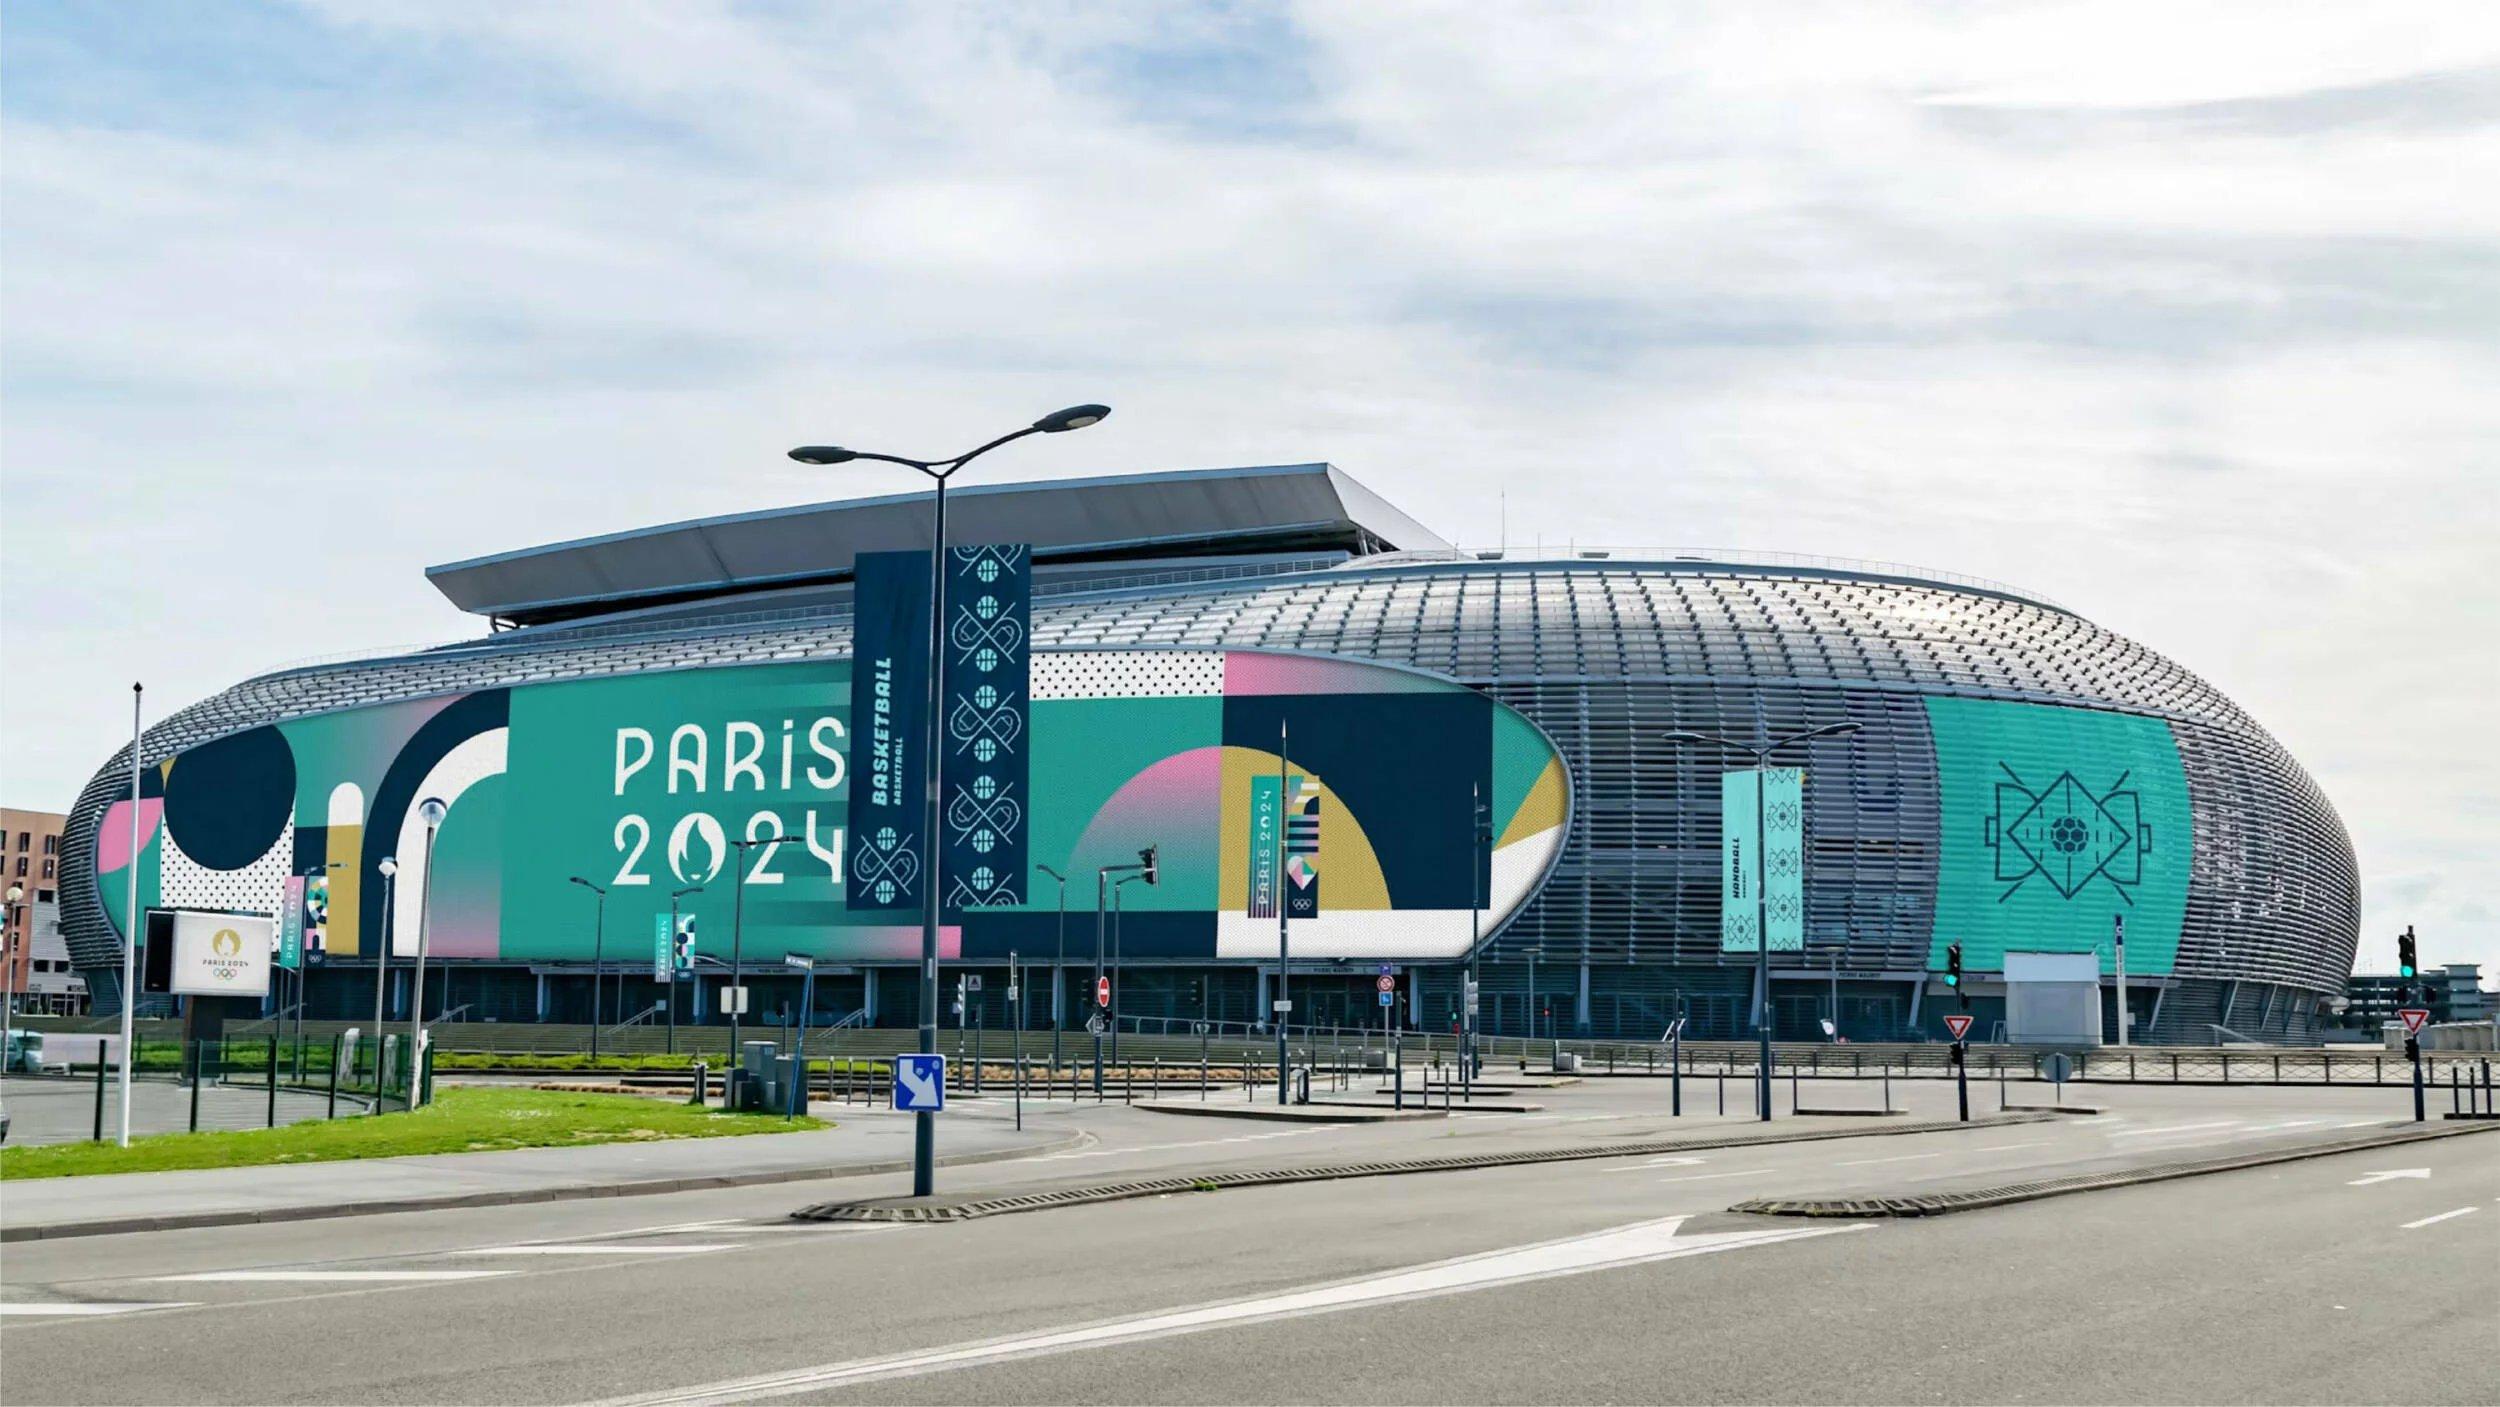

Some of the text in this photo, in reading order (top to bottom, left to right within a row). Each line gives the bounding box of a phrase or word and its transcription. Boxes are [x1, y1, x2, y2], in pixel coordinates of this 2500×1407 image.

[872, 658, 891, 805] BASKETBALL
[894, 737, 903, 805] BASKETBALL
[611, 810, 844, 885] 2024
[1259, 790, 1271, 904] PARIS 2024
[1732, 837, 1740, 898] HANDBALL
[227, 959, 248, 967] 2024
